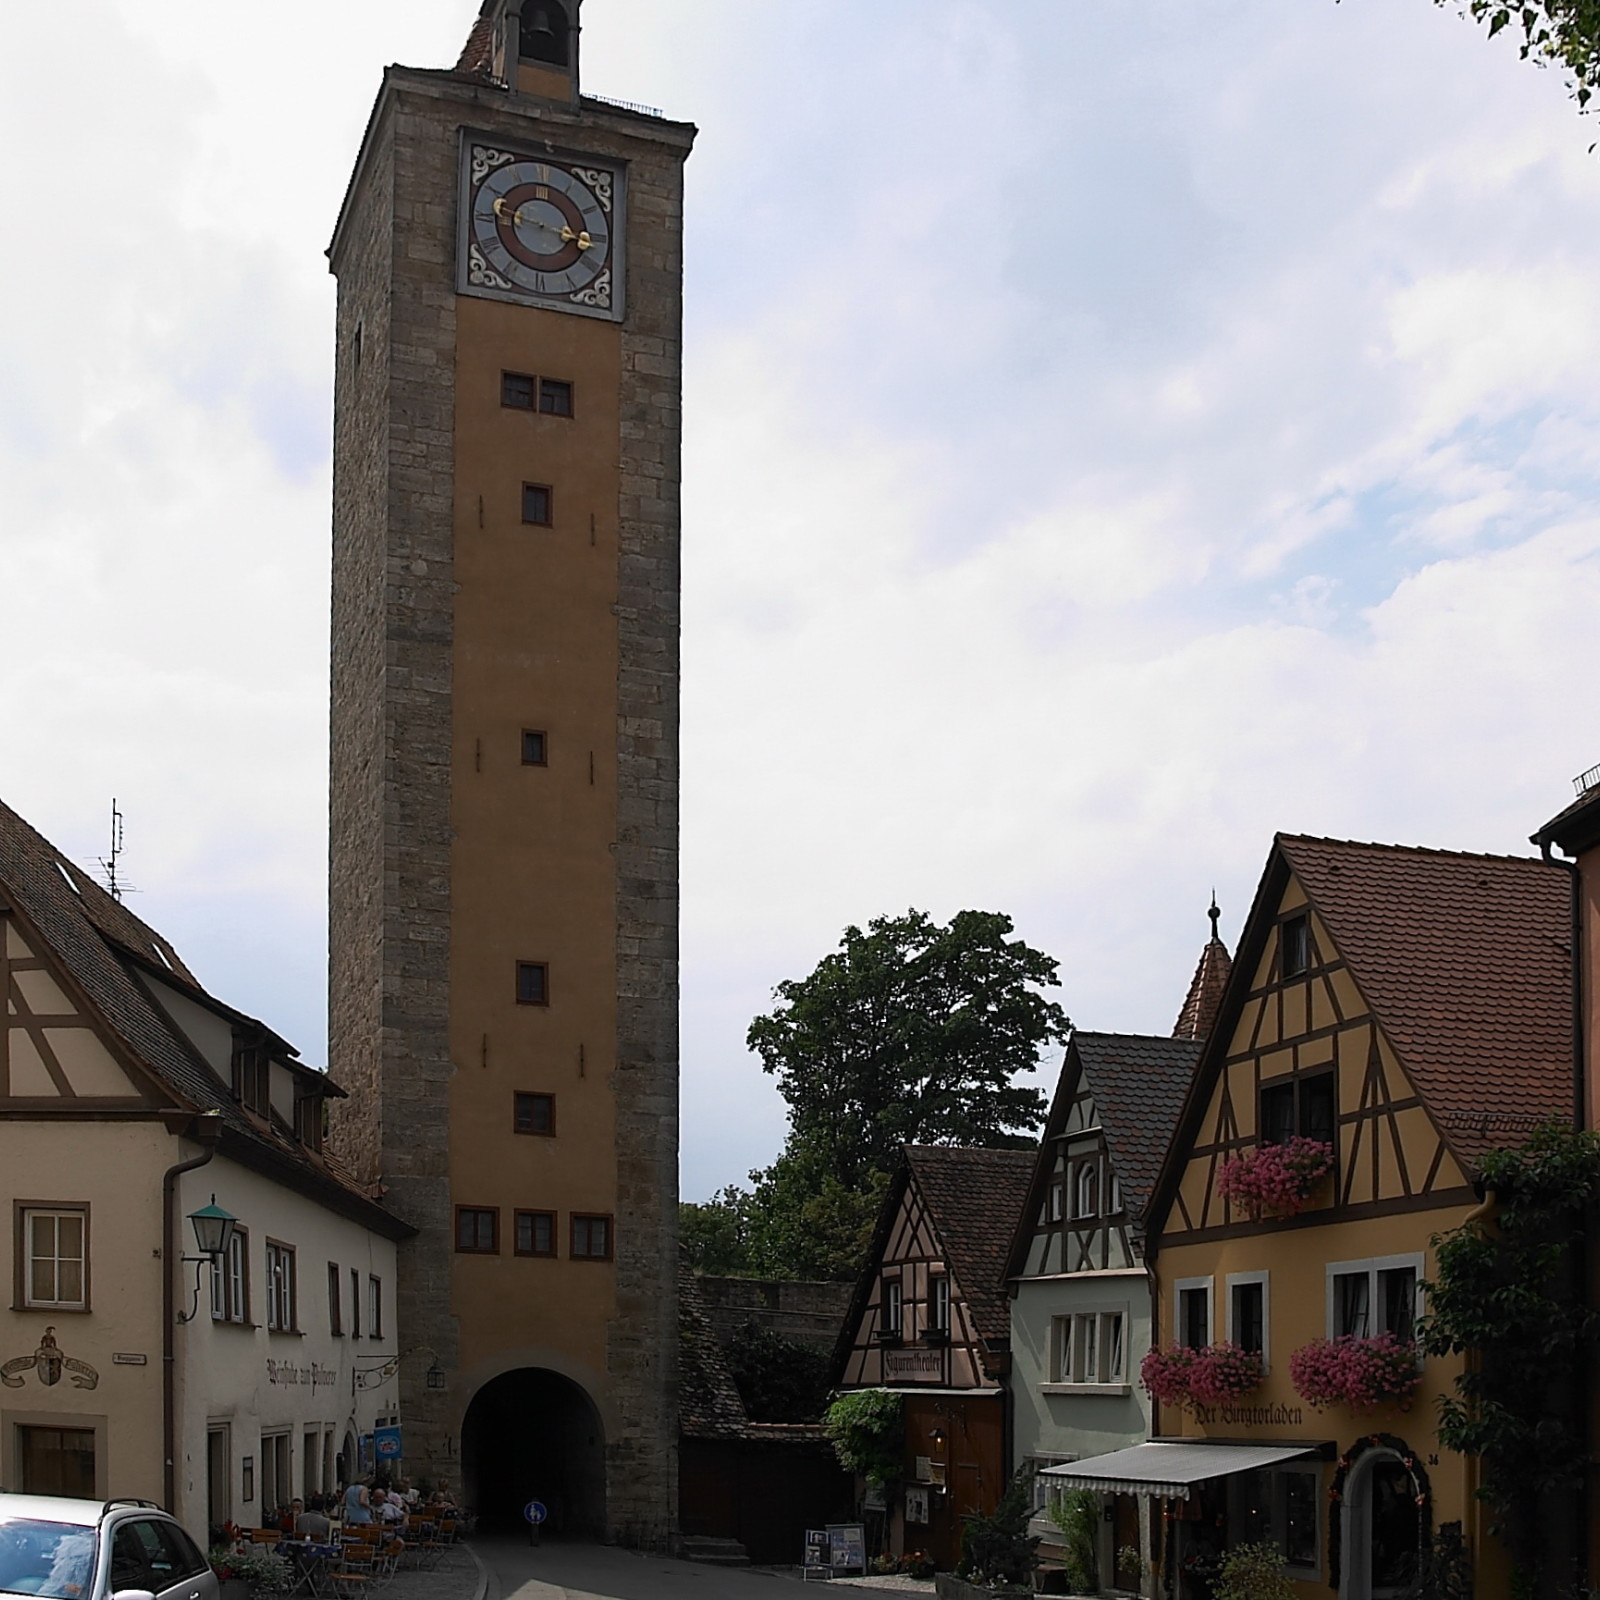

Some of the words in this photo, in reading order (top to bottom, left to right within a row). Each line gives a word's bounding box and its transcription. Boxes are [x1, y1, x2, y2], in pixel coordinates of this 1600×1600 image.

[885, 1350, 941, 1377] Figurentheater
[1194, 1402, 1217, 1425] Der
[1220, 1402, 1303, 1428] Burgtorladen
